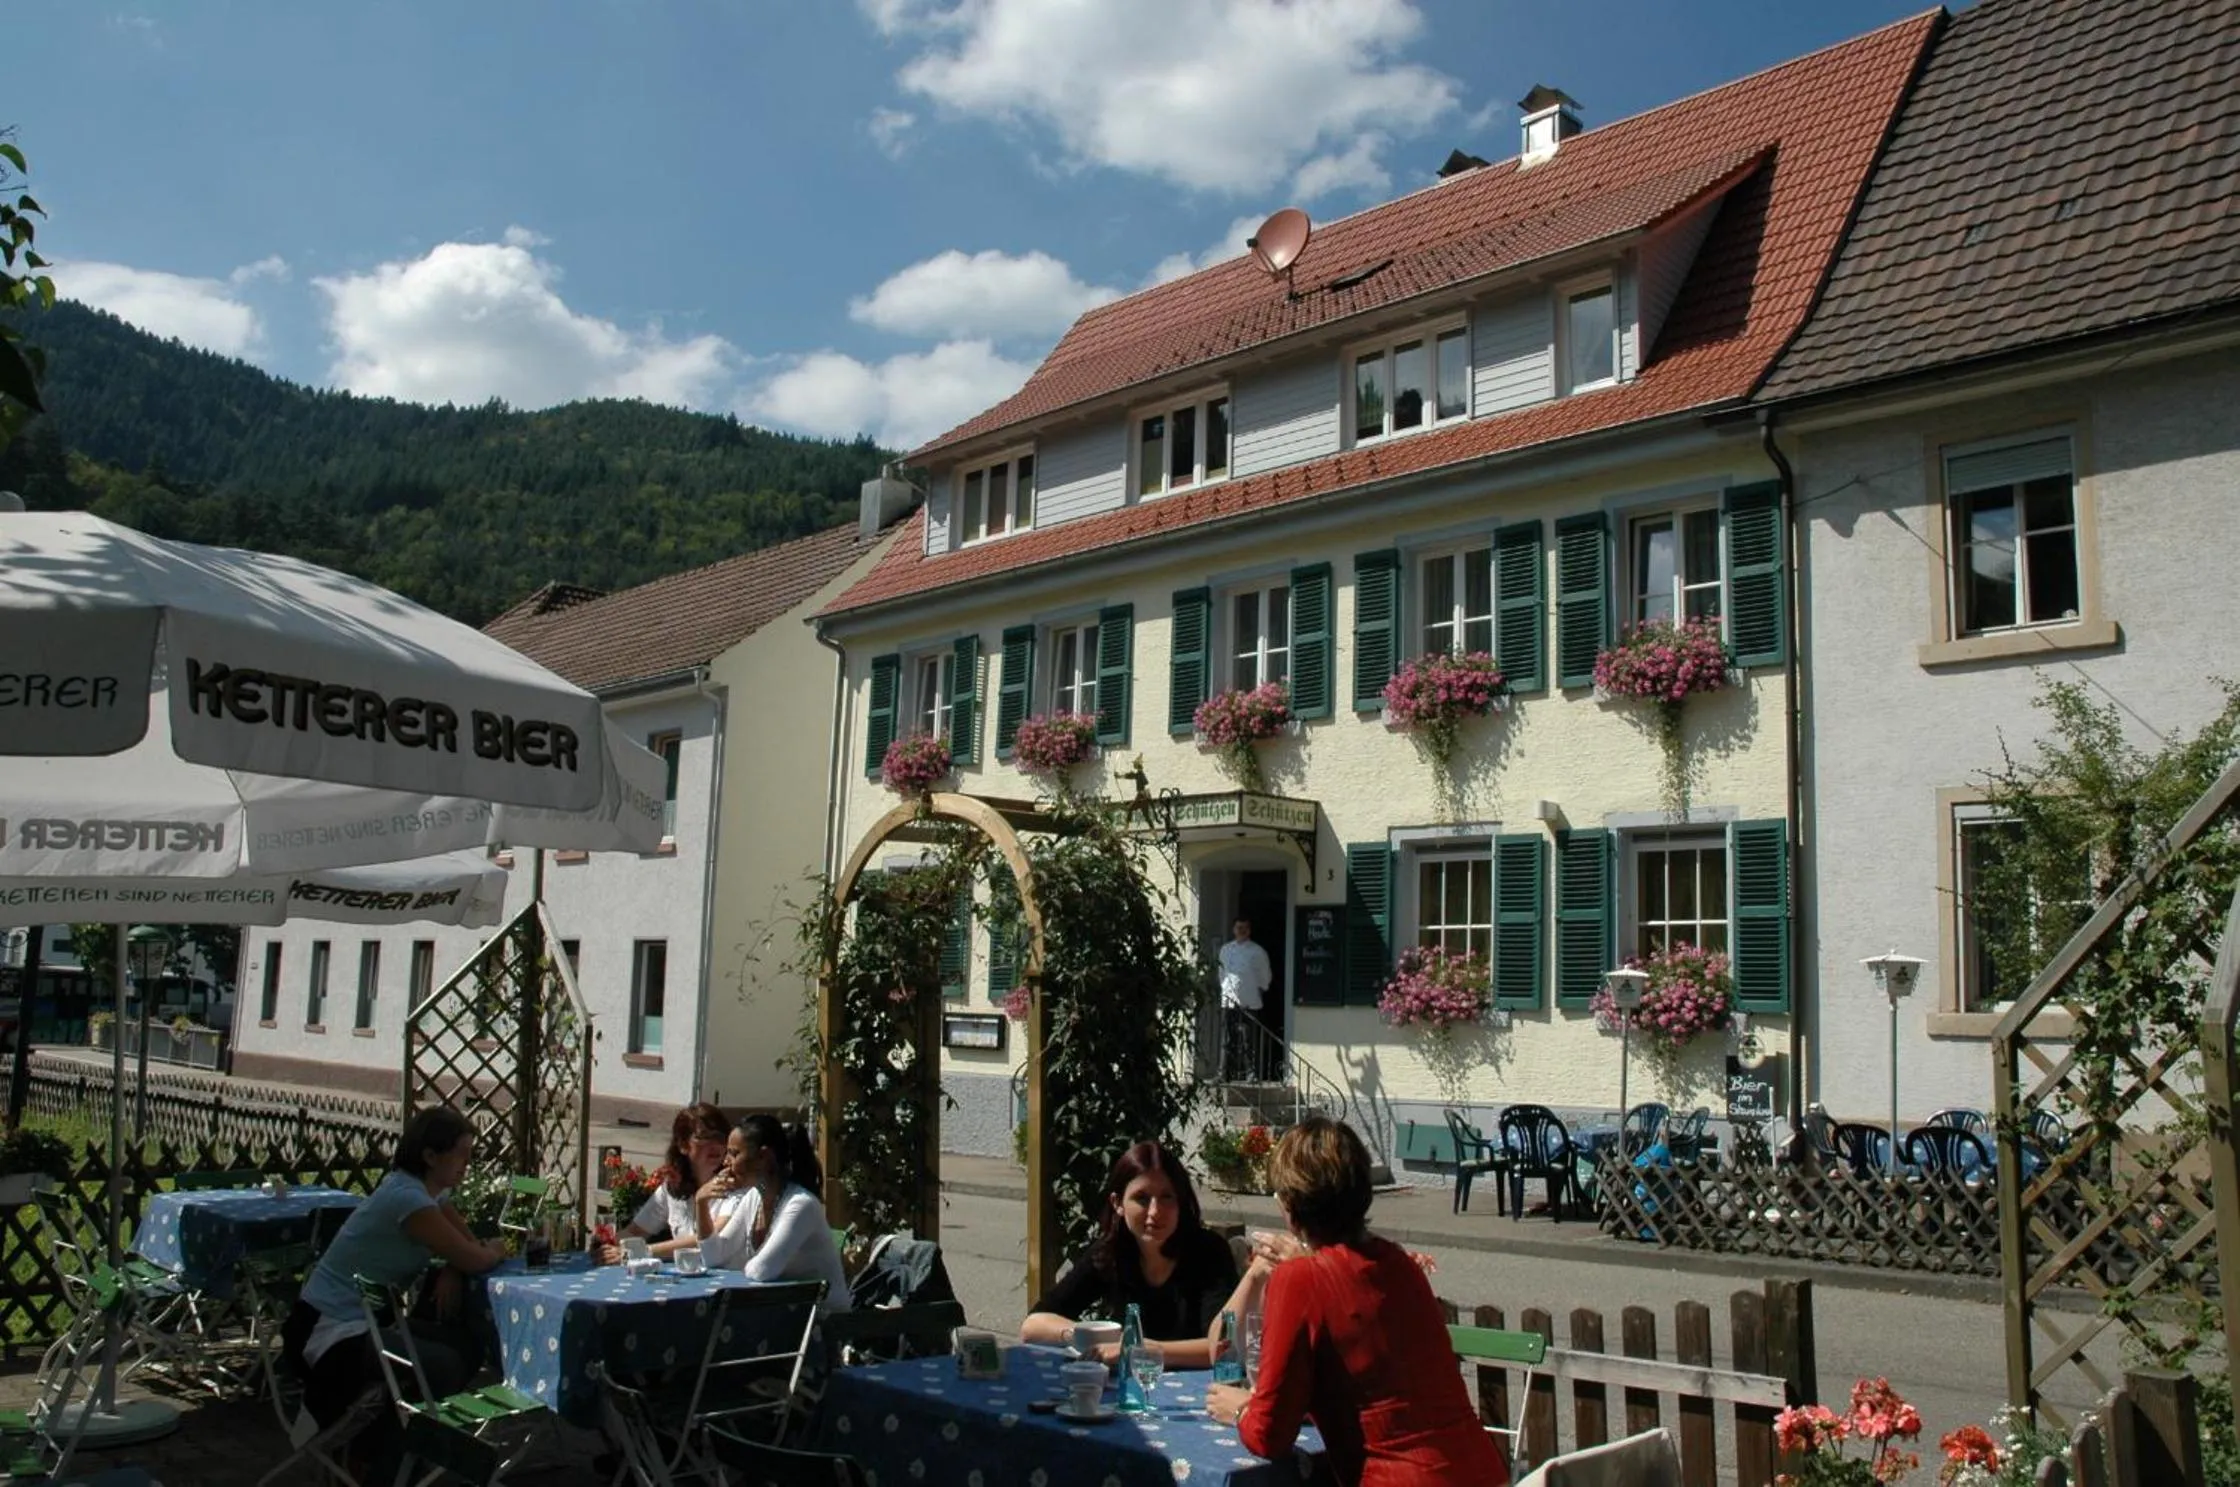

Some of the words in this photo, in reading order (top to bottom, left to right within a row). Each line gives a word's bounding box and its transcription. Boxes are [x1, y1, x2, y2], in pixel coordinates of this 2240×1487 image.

[185, 657, 459, 754] KETTERER
[471, 708, 579, 773] BIER
[1245, 799, 1313, 826] Schützen
[115, 887, 167, 902] SIND
[173, 889, 275, 905] NETTERER
[288, 879, 411, 911] KETTERER
[1728, 1074, 1767, 1093] Bier
